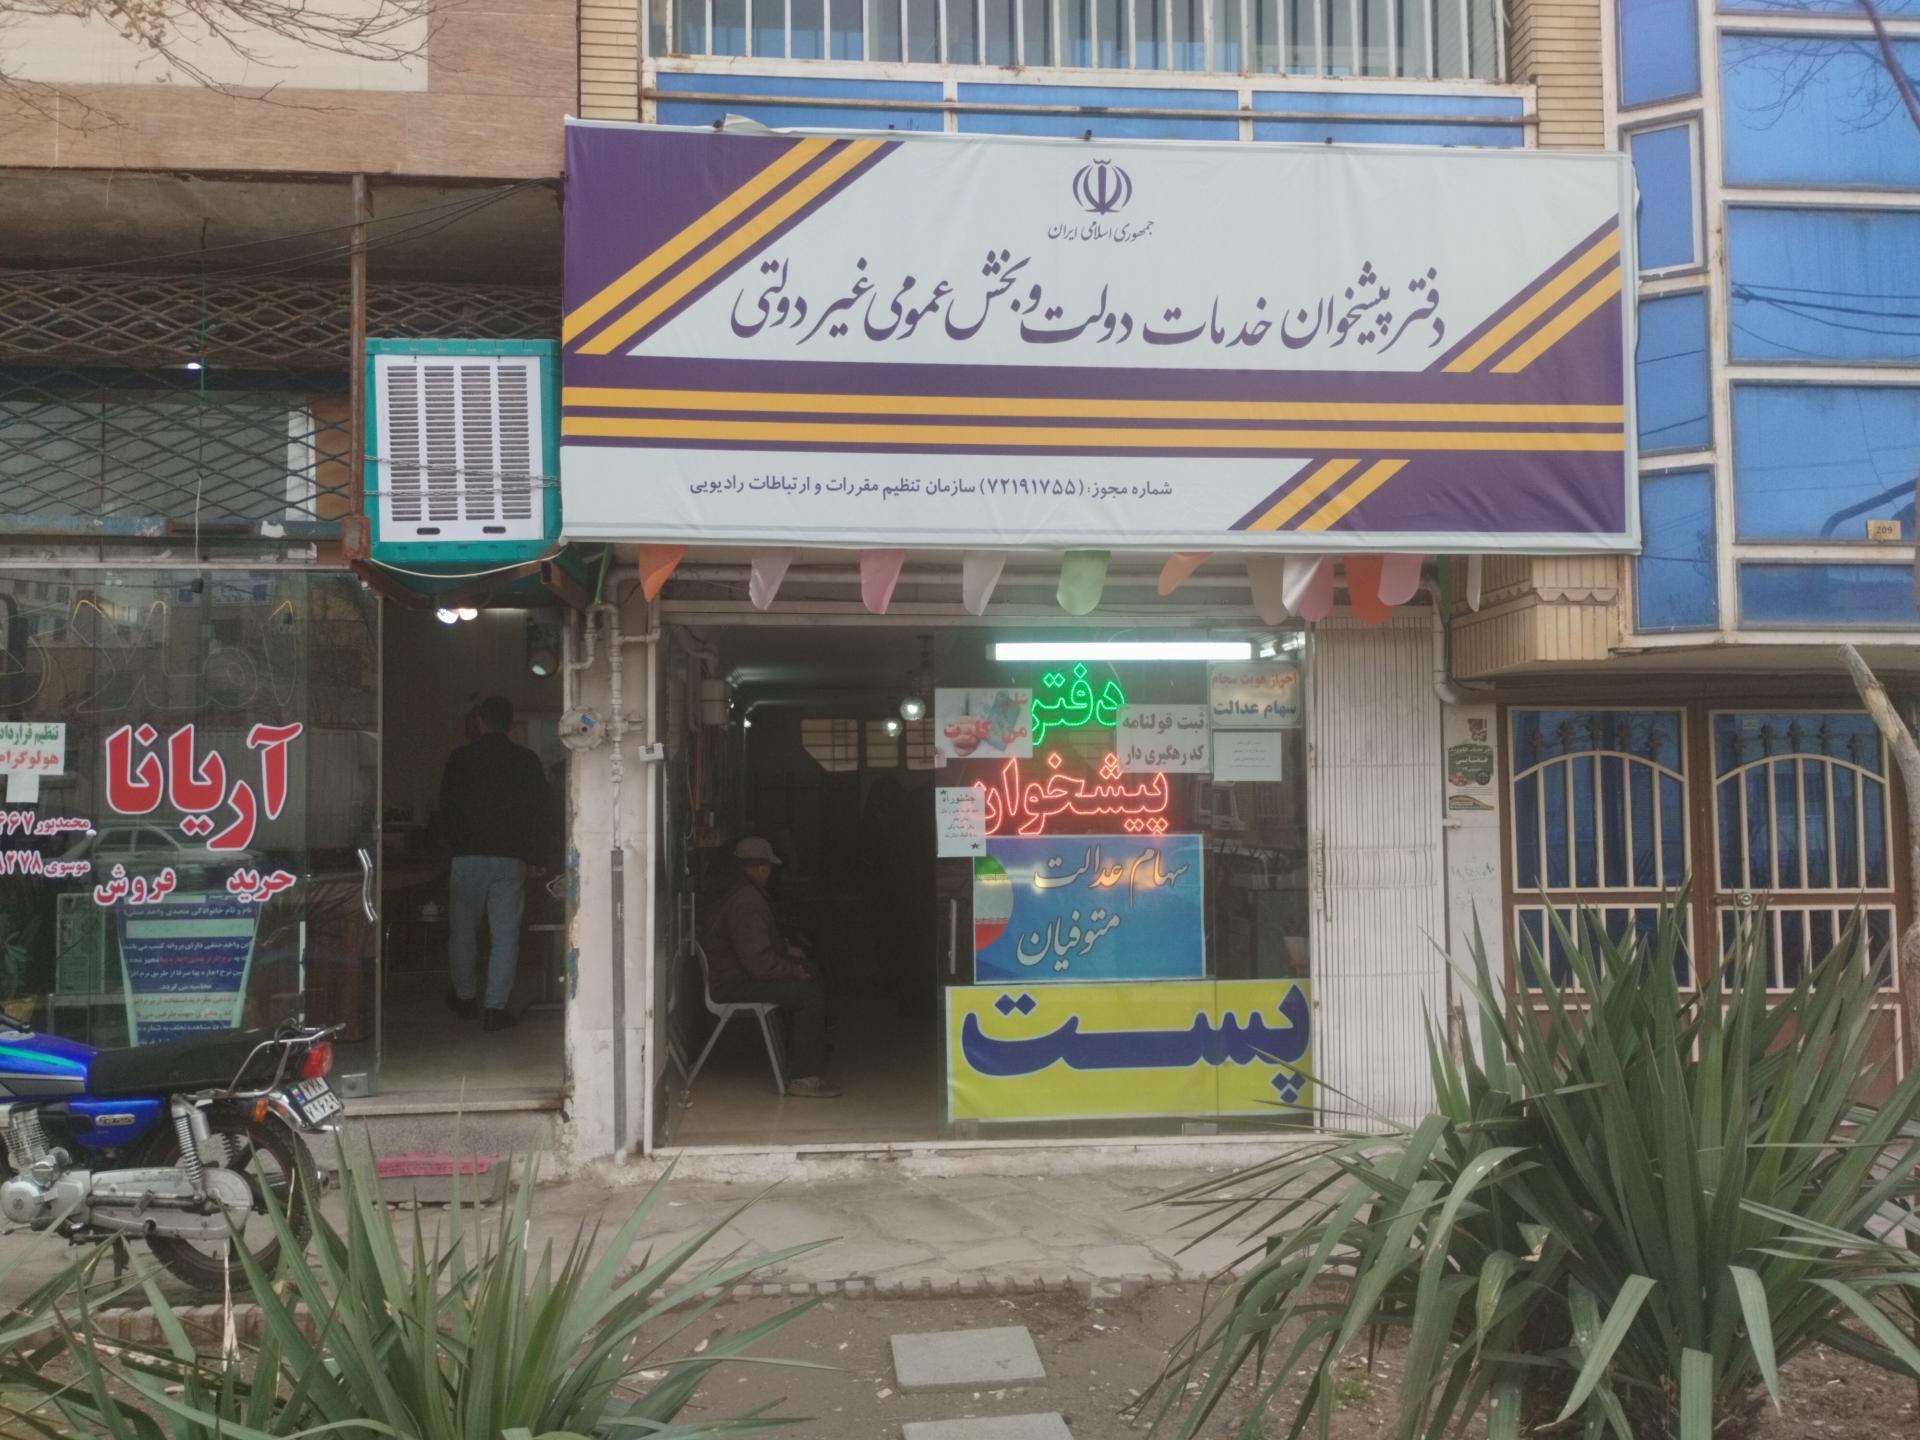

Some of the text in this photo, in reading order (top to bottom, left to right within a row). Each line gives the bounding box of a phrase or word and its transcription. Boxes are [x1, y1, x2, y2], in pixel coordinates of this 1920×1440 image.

[1047, 220, 1155, 243] جمهوری اسلامی ایران
[730, 257, 808, 339] دولتی
[796, 256, 875, 346] غیر
[863, 274, 954, 342] عمومی
[944, 249, 1032, 341] بخش
[1020, 282, 1134, 345] دولت
[1280, 260, 1393, 350] پیشخوان
[1376, 266, 1446, 355] دفتر
[1142, 295, 1273, 349] خدمات
[690, 474, 744, 494] رادیویی
[749, 475, 809, 495] ارتباطات
[815, 482, 822, 495] و
[825, 477, 879, 495] مقررات
[883, 478, 921, 500] تنظیم
[925, 477, 976, 496] سازمان
[1087, 480, 1128, 499] مجوز:
[1132, 480, 1173, 499] شماره
[1176, 711, 1205, 734] ثبت
[1213, 699, 1297, 719] سهام عدالت
[105, 722, 304, 852] آریانا
[44, 860, 91, 878] موسوی
[93, 863, 177, 906] فروش
[1033, 844, 1190, 912] سهام عدالت
[1016, 908, 1121, 972] متوفیان
[961, 983, 1311, 1105] پست
